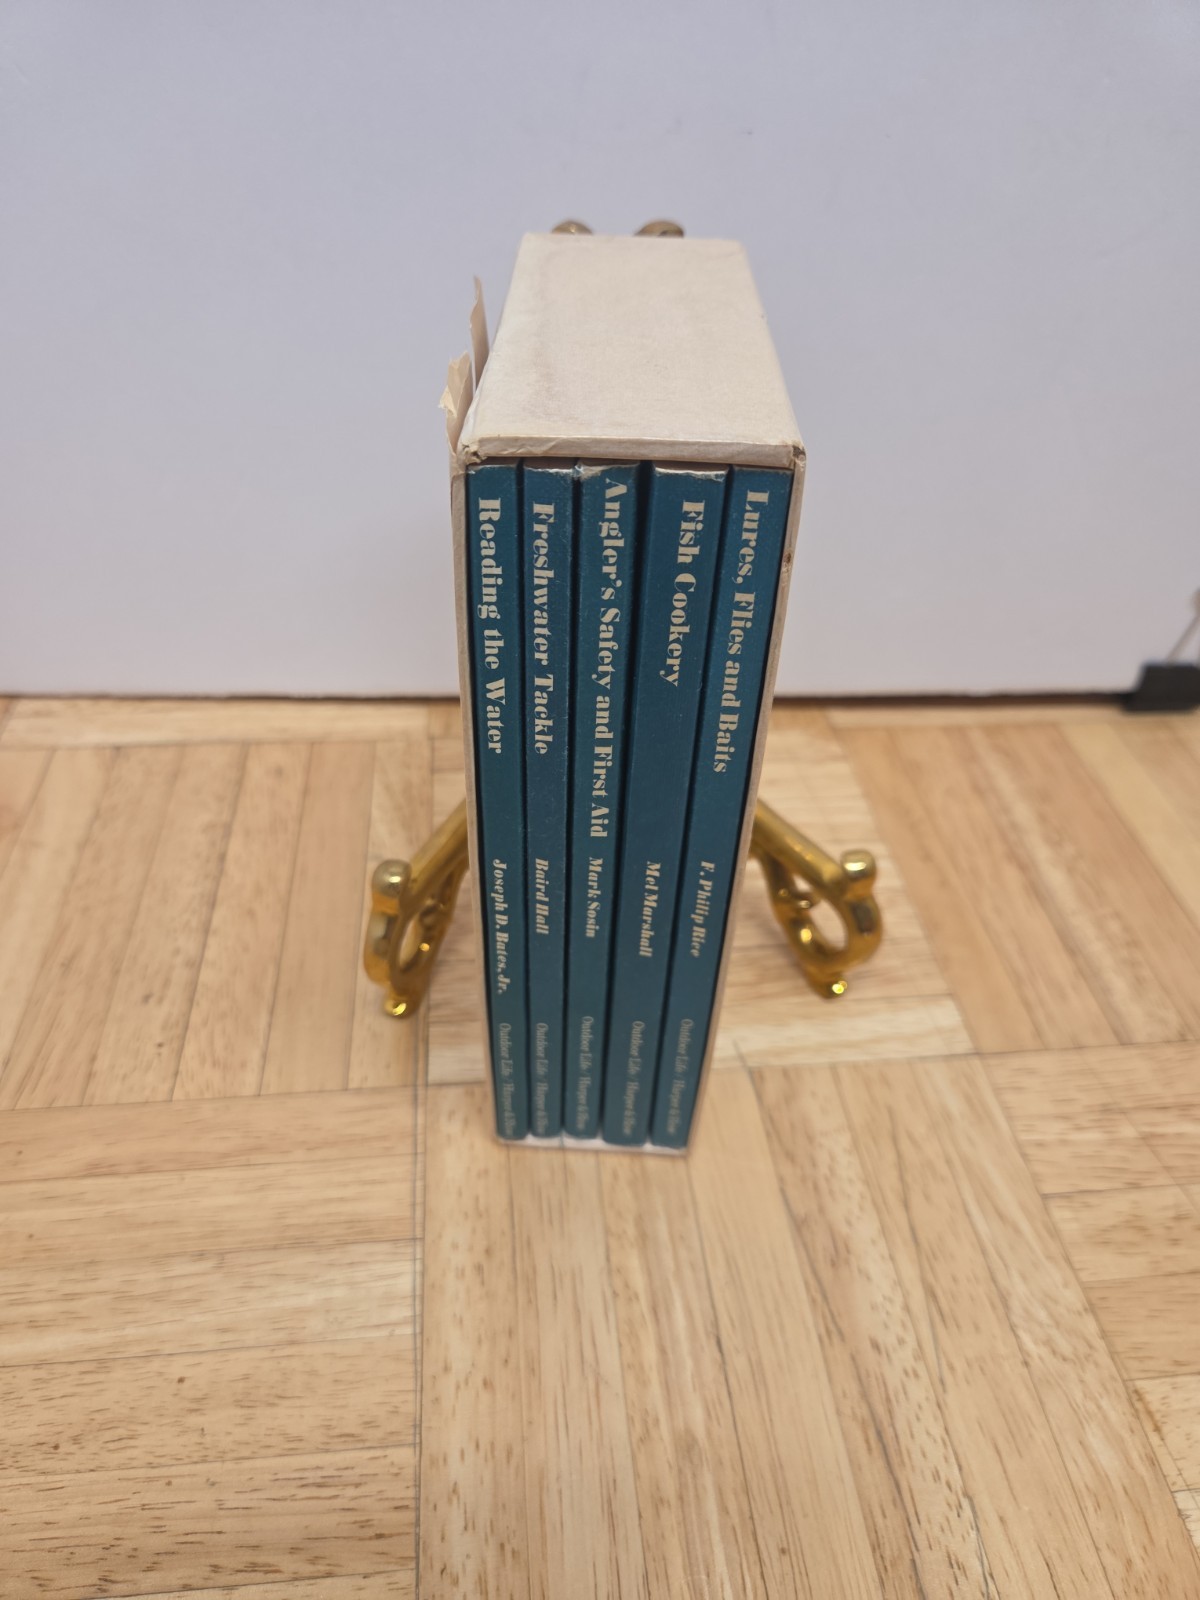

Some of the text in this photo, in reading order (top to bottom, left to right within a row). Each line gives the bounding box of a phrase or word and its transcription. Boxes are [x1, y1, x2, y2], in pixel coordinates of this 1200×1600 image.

[659, 500, 705, 687] Fish Cookery
[478, 498, 506, 754] Reading the Water
[532, 502, 554, 755] Freshwater Tackle
[713, 491, 769, 773] Lures, Flies and Baits
[590, 478, 628, 838] Angler's Safety and First Aid
[491, 859, 508, 912] Joseph
[535, 858, 549, 935] Baird Hall
[585, 857, 603, 938] Mark Sosin
[495, 914, 508, 929] D.
[639, 861, 661, 958] Mel Marshall
[690, 861, 715, 958] F. Philip Rice
[497, 974, 511, 994] Jr.
[499, 1023, 512, 1058] Outdoor
[536, 1023, 548, 1058] Outdoor
[580, 1016, 594, 1051] Outdoor
[629, 1021, 645, 1056] Outdoor
[677, 1019, 693, 1054] Outdoor
[500, 1059, 513, 1075] Life
[536, 1059, 548, 1075] Life
[580, 1053, 593, 1069] Life
[628, 1058, 641, 1074] Life
[675, 1056, 689, 1072] Life
